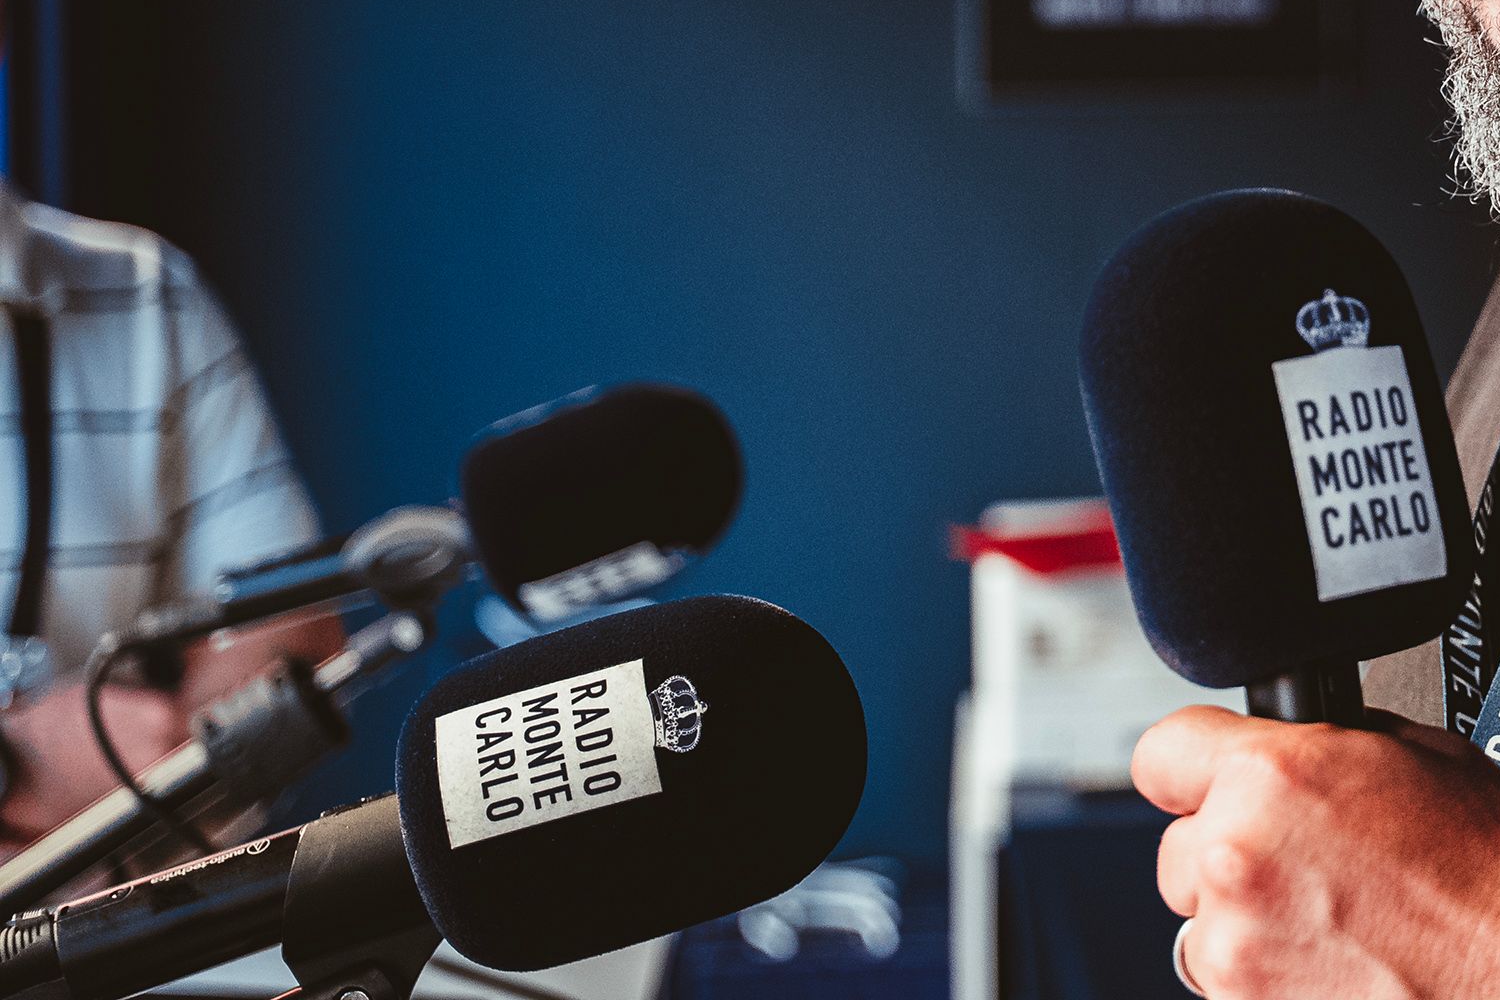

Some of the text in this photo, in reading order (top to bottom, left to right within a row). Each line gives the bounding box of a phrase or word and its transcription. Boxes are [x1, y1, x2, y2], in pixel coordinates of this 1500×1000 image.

[1296, 385, 1409, 441] RADIO
[1308, 439, 1420, 496] MONTE
[1319, 491, 1431, 549] CARLO
[474, 706, 525, 823] CARLO
[521, 692, 573, 810] MONTE
[570, 679, 622, 796] RADIO
